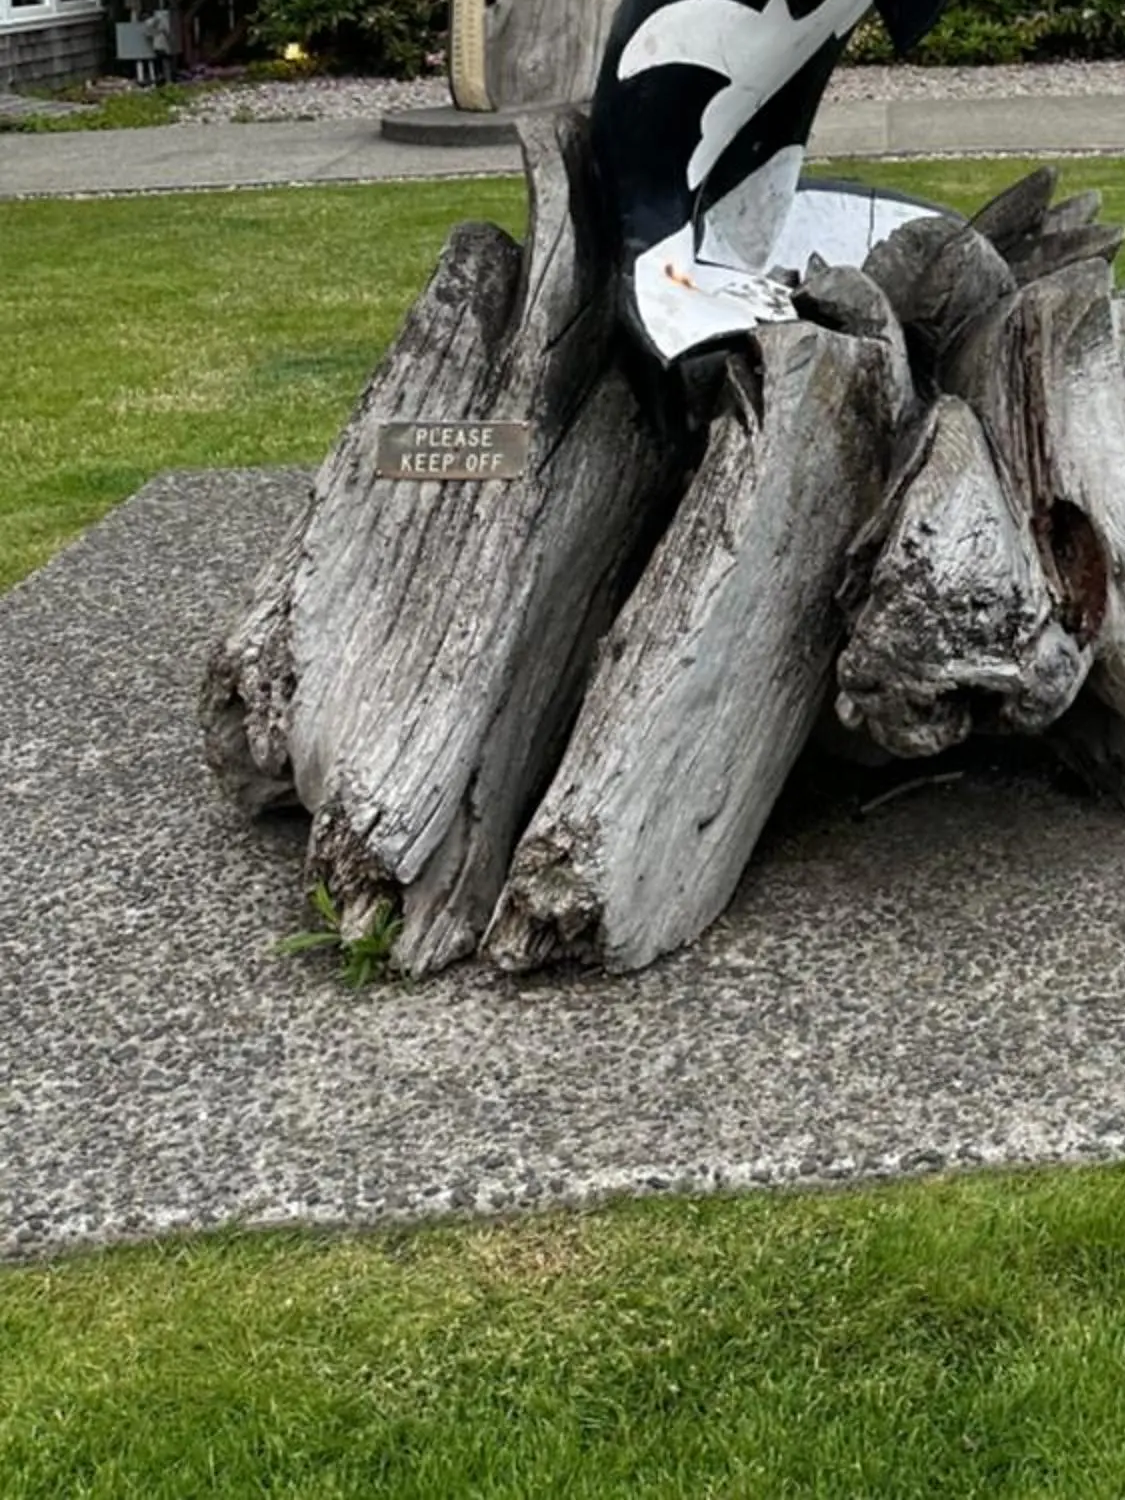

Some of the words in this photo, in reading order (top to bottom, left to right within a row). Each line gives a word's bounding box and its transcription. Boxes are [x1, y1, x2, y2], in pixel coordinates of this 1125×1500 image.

[415, 427, 494, 447] PLEASE
[400, 453, 455, 472] KEEP
[465, 453, 504, 472] OFF
